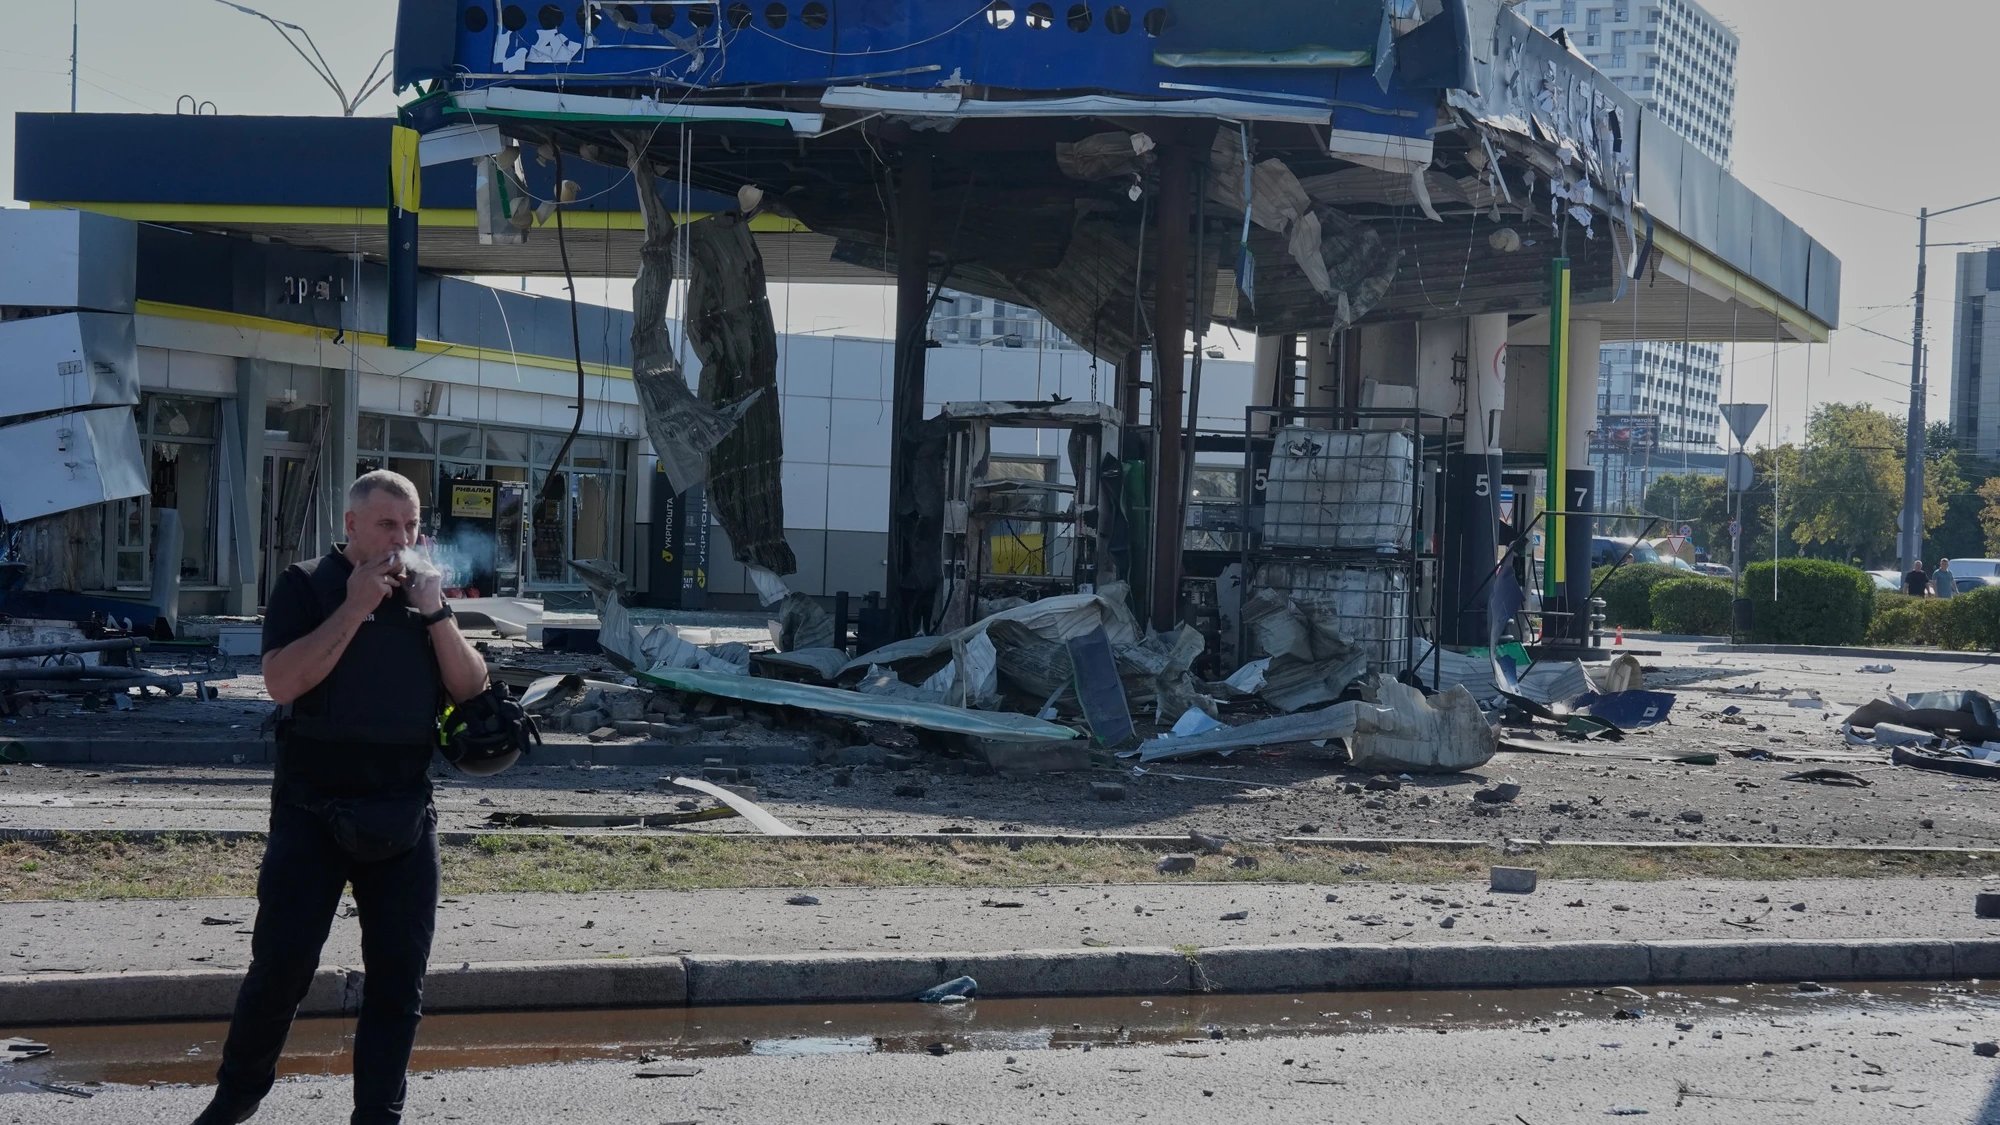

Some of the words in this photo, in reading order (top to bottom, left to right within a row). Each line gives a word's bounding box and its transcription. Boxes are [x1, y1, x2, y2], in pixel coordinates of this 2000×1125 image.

[1255, 468, 1267, 490] 5
[1475, 474, 1490, 496] 5
[1574, 487, 1588, 507] 7
[664, 497, 674, 549] УКРПОШТА
